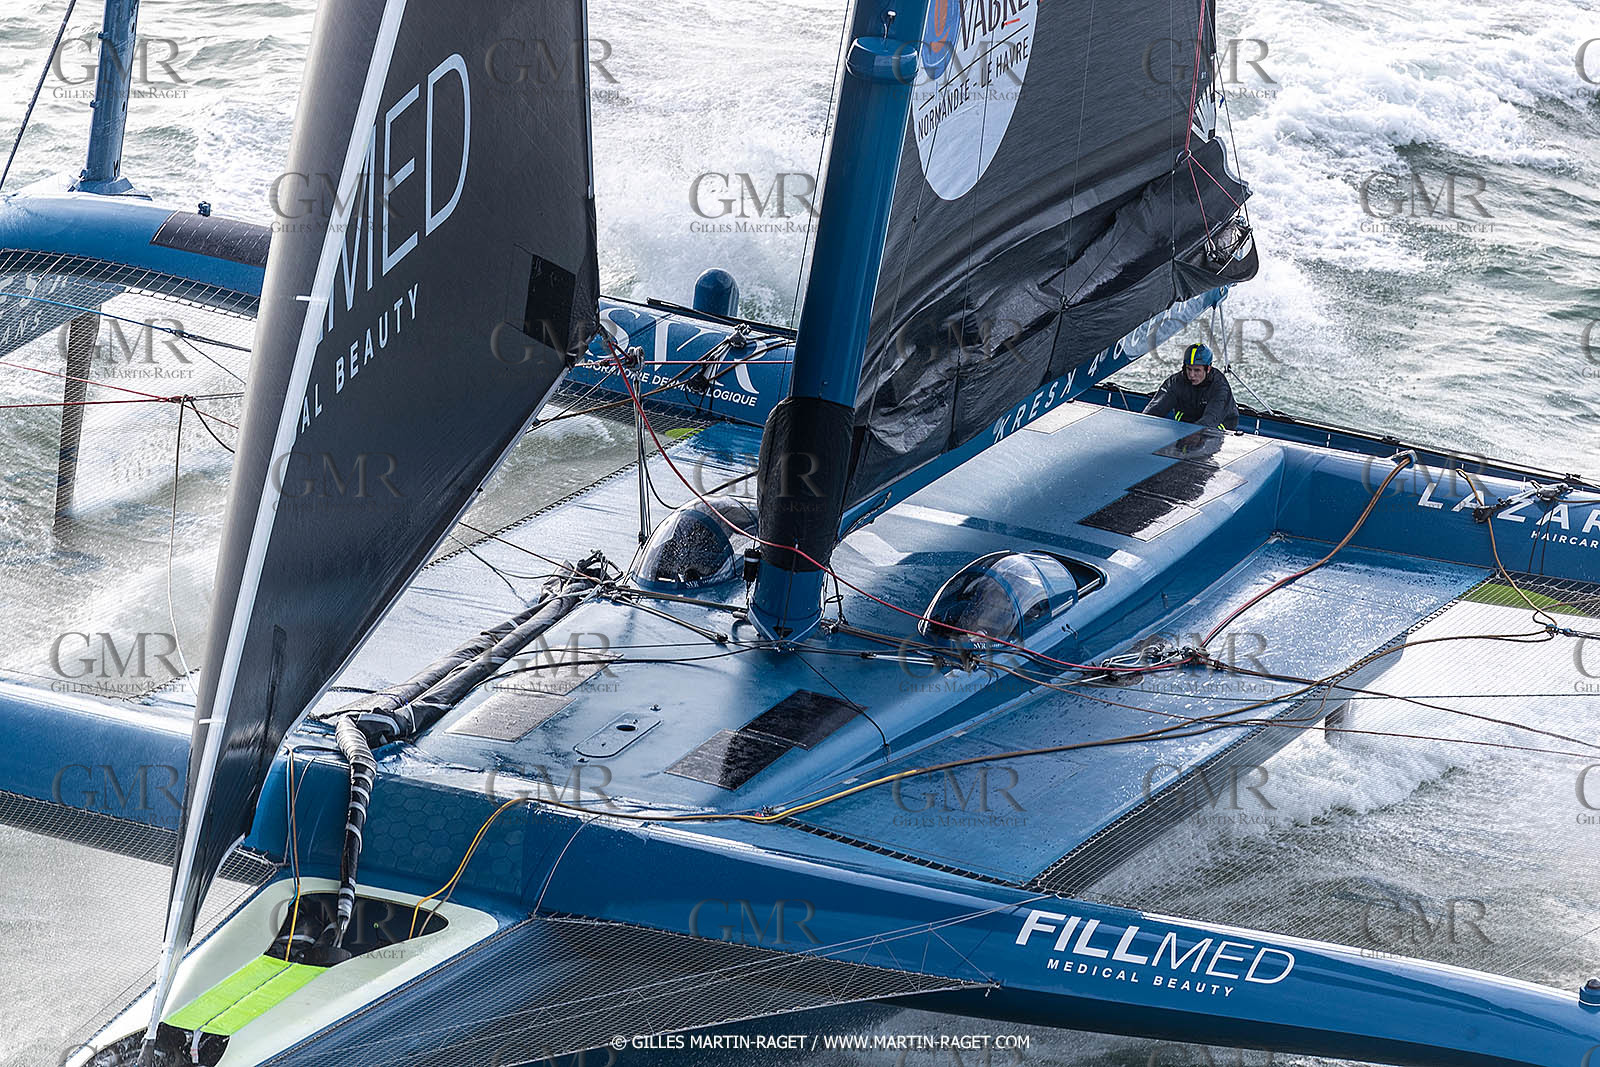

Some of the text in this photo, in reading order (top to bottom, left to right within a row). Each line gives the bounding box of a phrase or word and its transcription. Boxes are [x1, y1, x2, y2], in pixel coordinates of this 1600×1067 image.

[918, 79, 970, 142] NORMANDIE
[996, 36, 1029, 78] HAVRE
[336, 283, 419, 394] BEAUTY
[1015, 909, 1296, 985] FILLMED
[1047, 958, 1235, 998] MEDICAL BEAUTY
